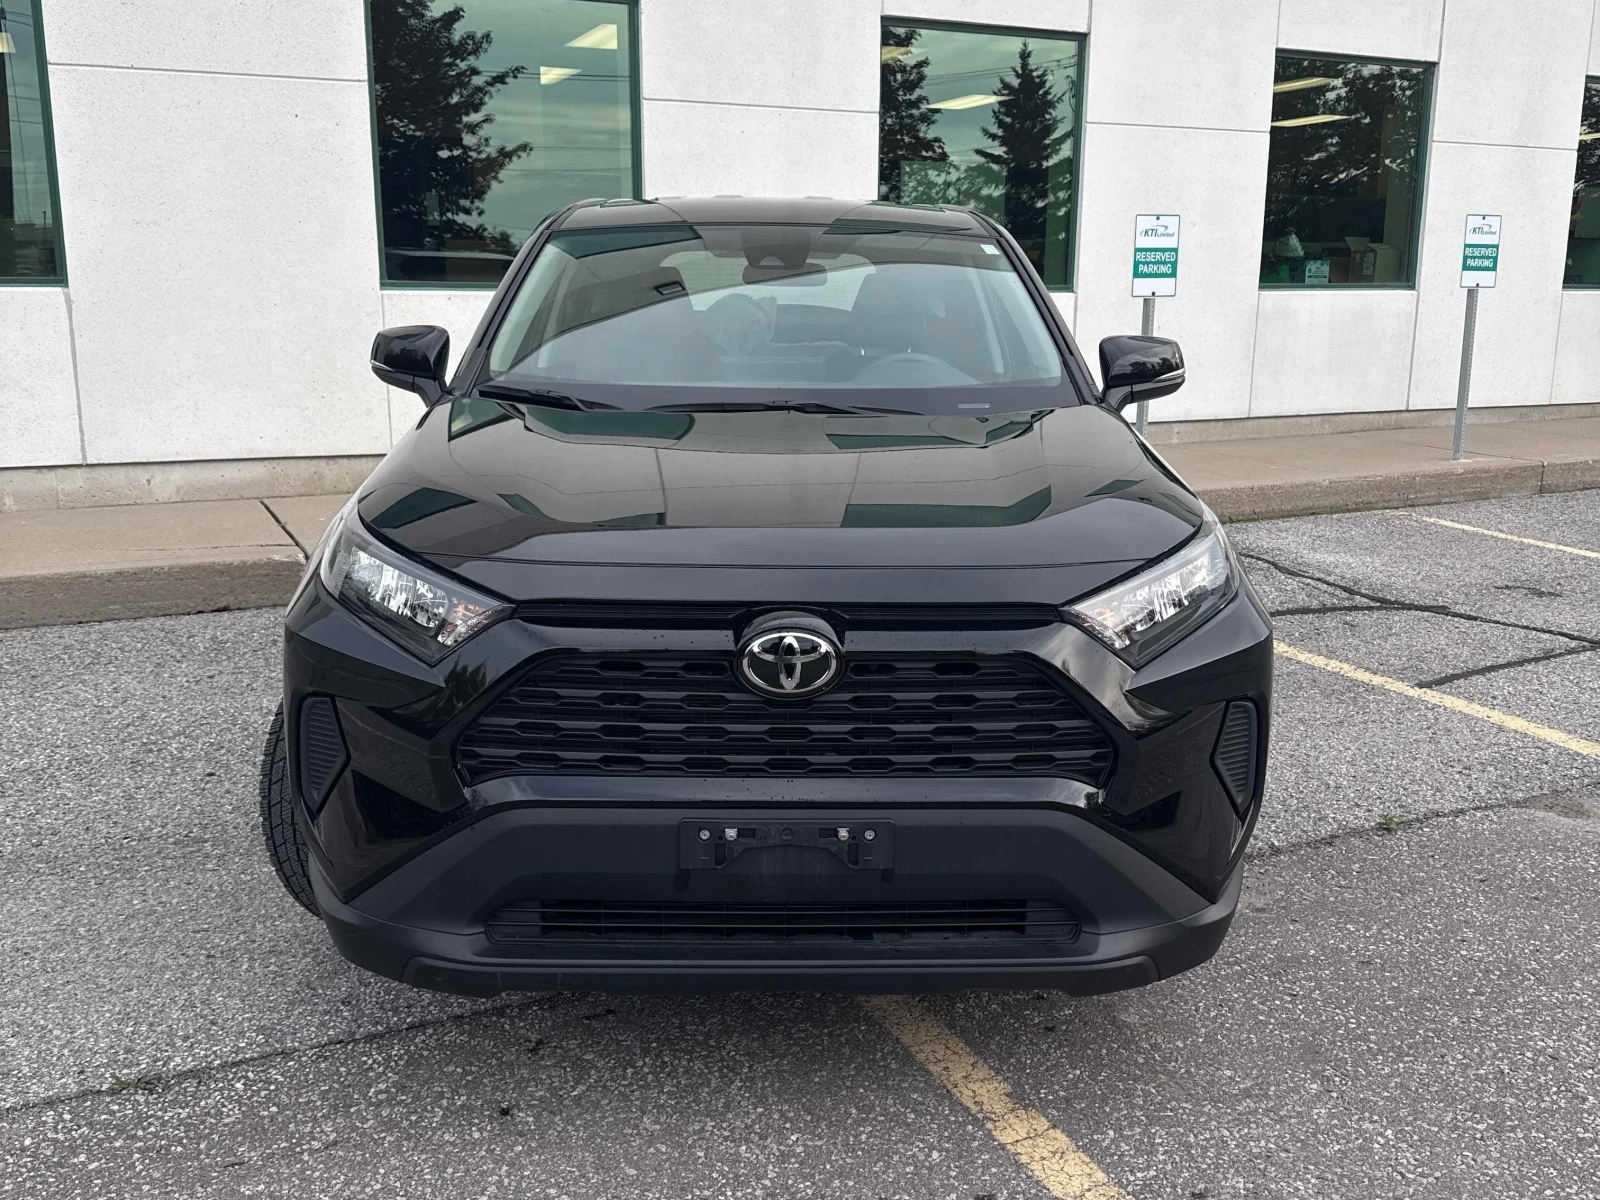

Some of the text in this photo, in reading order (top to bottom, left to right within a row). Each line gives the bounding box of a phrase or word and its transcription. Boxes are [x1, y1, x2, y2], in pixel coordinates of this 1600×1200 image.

[1144, 228, 1157, 237] KTI
[1472, 227, 1483, 235] KTI
[1135, 251, 1176, 261] RESERVED
[1465, 247, 1497, 256] RESERVED
[1466, 258, 1494, 267] PARKING
[1138, 263, 1172, 274] PARKING
